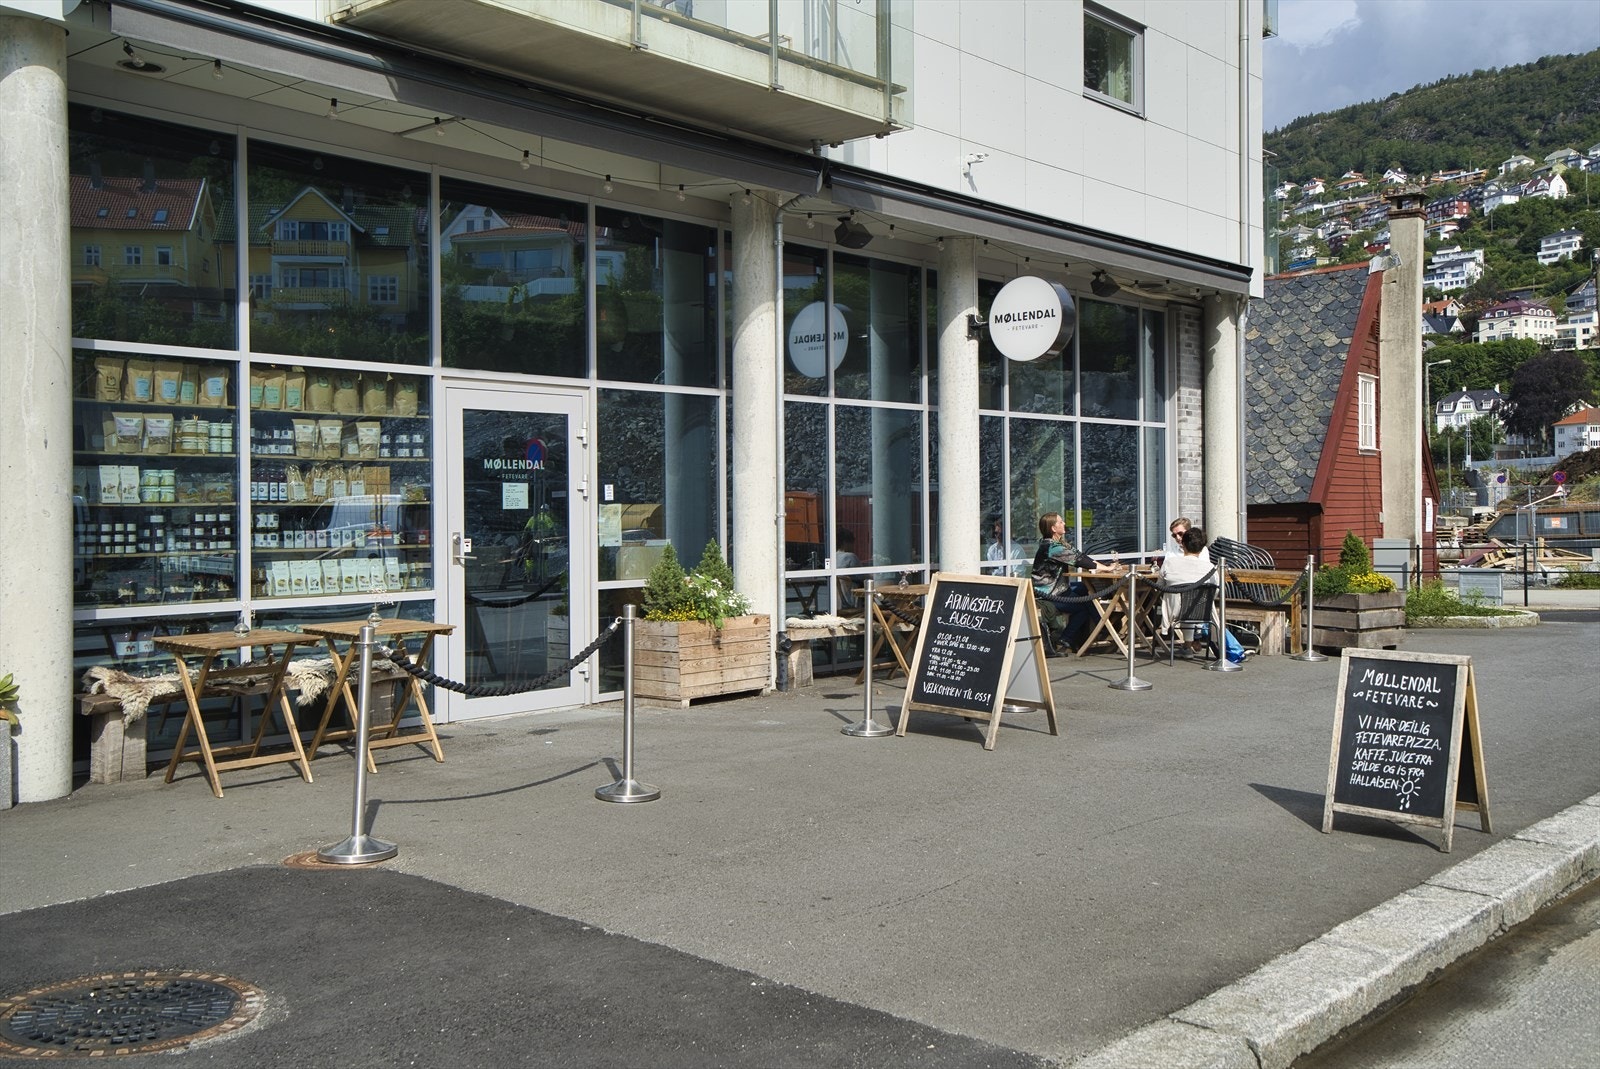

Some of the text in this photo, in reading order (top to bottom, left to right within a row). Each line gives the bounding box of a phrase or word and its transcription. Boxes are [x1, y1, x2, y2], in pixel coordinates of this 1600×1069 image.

[994, 308, 1056, 324] MØLLENDAL
[1011, 323, 1039, 331] FETEVARE
[483, 458, 545, 470] MØLLENDAL
[949, 611, 989, 628] AUGUST
[1360, 668, 1441, 693] MØLLENDAL
[923, 681, 992, 706] VELKOMMEN TIL OSS!
[1365, 689, 1425, 709] FETEVARE
[1358, 714, 1372, 729] VI
[1374, 716, 1396, 731] HAR
[1414, 754, 1434, 766] FRA
[1383, 764, 1396, 774] OG
[1407, 767, 1425, 778] FRA
